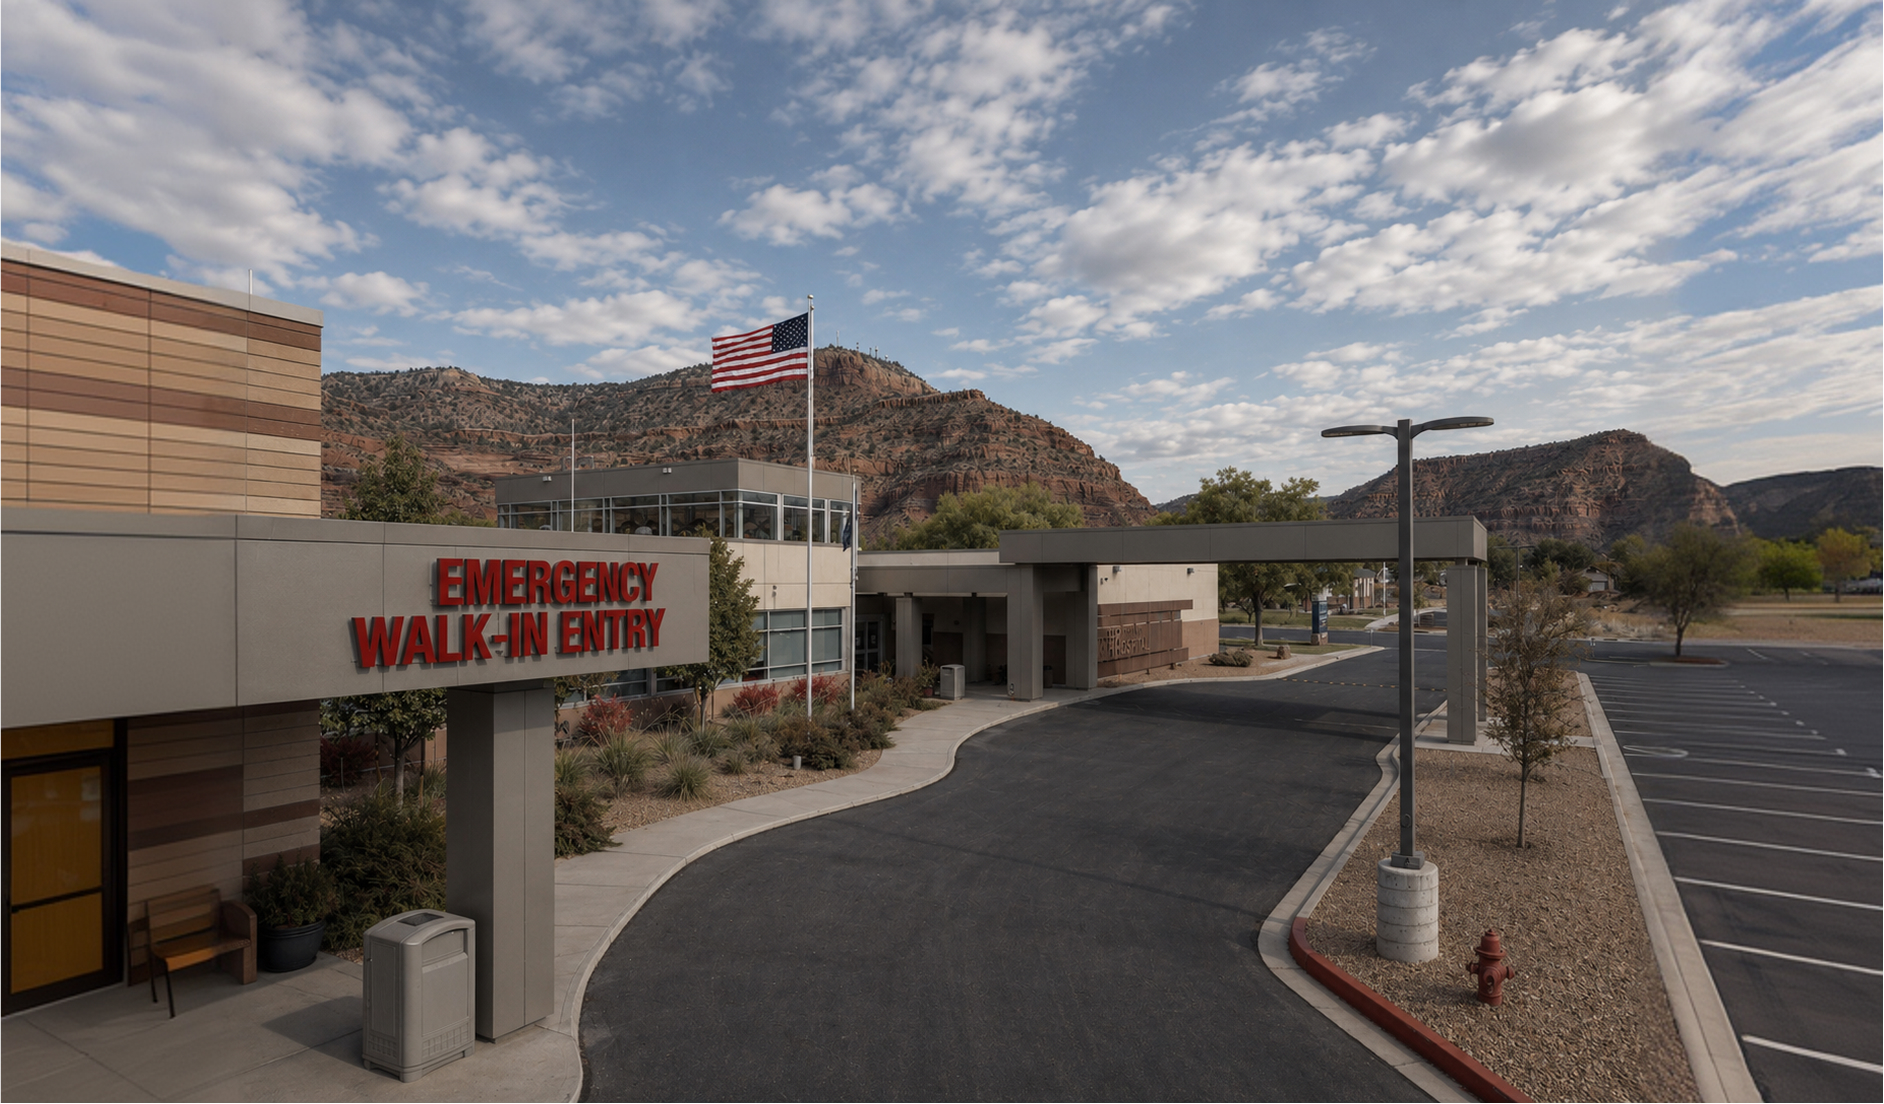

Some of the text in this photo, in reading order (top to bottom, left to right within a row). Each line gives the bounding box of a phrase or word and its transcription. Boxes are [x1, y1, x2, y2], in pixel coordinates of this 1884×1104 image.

[436, 558, 659, 606] EMERGENCY
[352, 608, 666, 668] WALK-IN ENTRY
